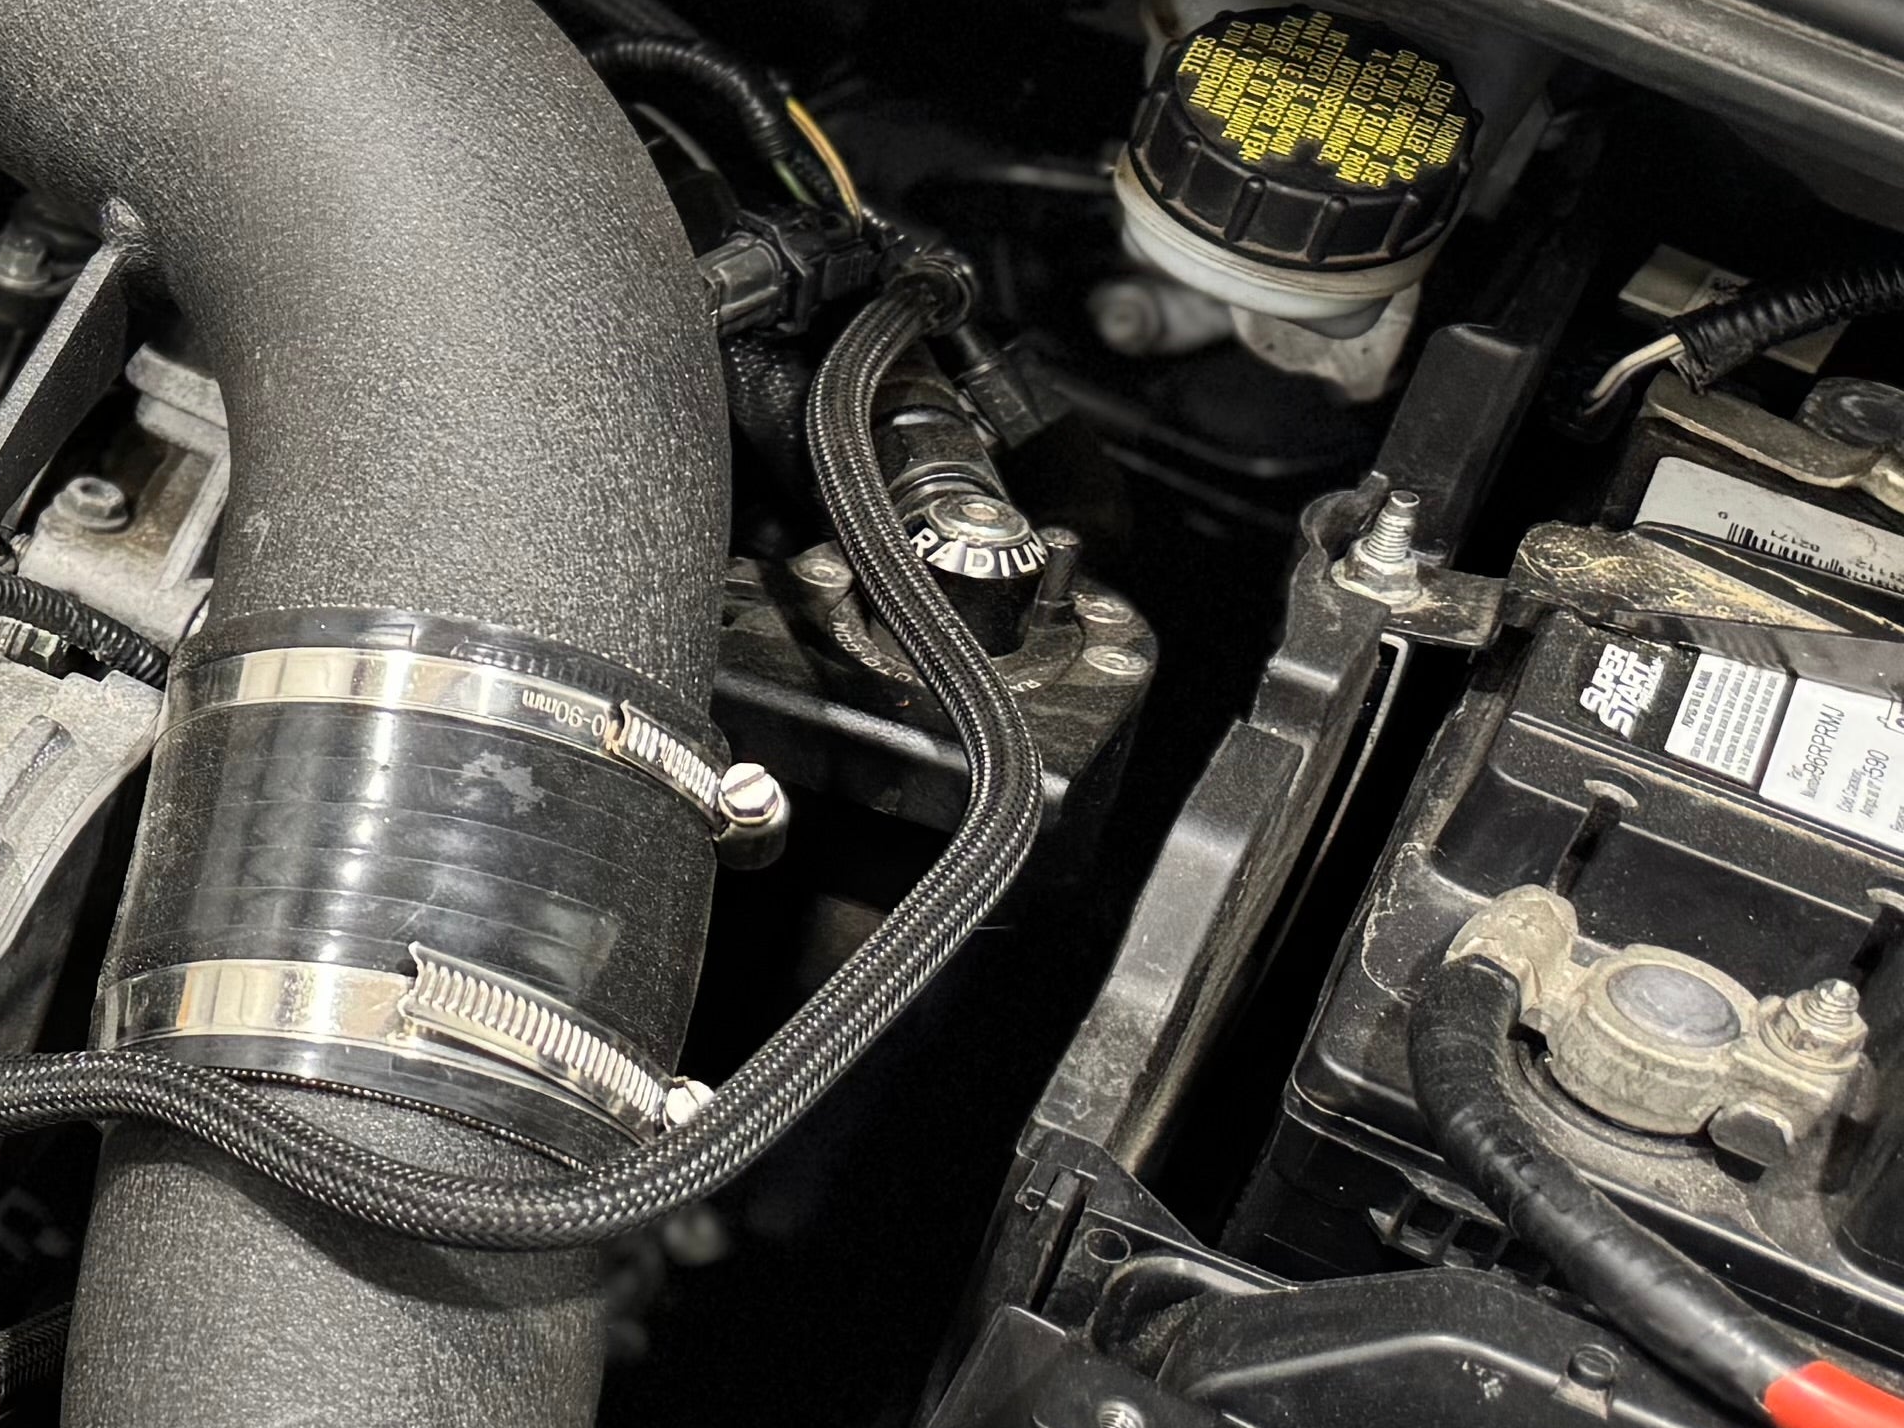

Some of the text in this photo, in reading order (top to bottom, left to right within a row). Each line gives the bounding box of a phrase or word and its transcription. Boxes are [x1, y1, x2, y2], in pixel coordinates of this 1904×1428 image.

[1267, 14, 1303, 55] PLOYER
[1290, 43, 1313, 62] DE
[1299, 10, 1331, 44] AVANT
[1188, 45, 1235, 108] CONTENANT
[1207, 22, 1274, 119] DOT 4 PROVENANT
[1255, 55, 1281, 78] QUE
[1281, 61, 1305, 78] LE
[1306, 28, 1348, 82] NETTOYER
[1220, 97, 1260, 143] LIQUIDE
[1268, 102, 1310, 156] BOUCHON
[1316, 48, 1390, 164] A SEALED CONTAINER.
[1335, 48, 1417, 183] ONLY DOT 4 FLUID FROM
[1359, 59, 1438, 188] BEFORE REMOVING. USE
[1390, 79, 1455, 181] CLEAN FILLER CAP
[1423, 113, 1465, 166] WARNING:
[1580, 643, 1629, 713] SUPER
[1598, 651, 1651, 741] START
[1803, 703, 1845, 776] 96RPRMJ
[1863, 748, 1890, 779] 590
